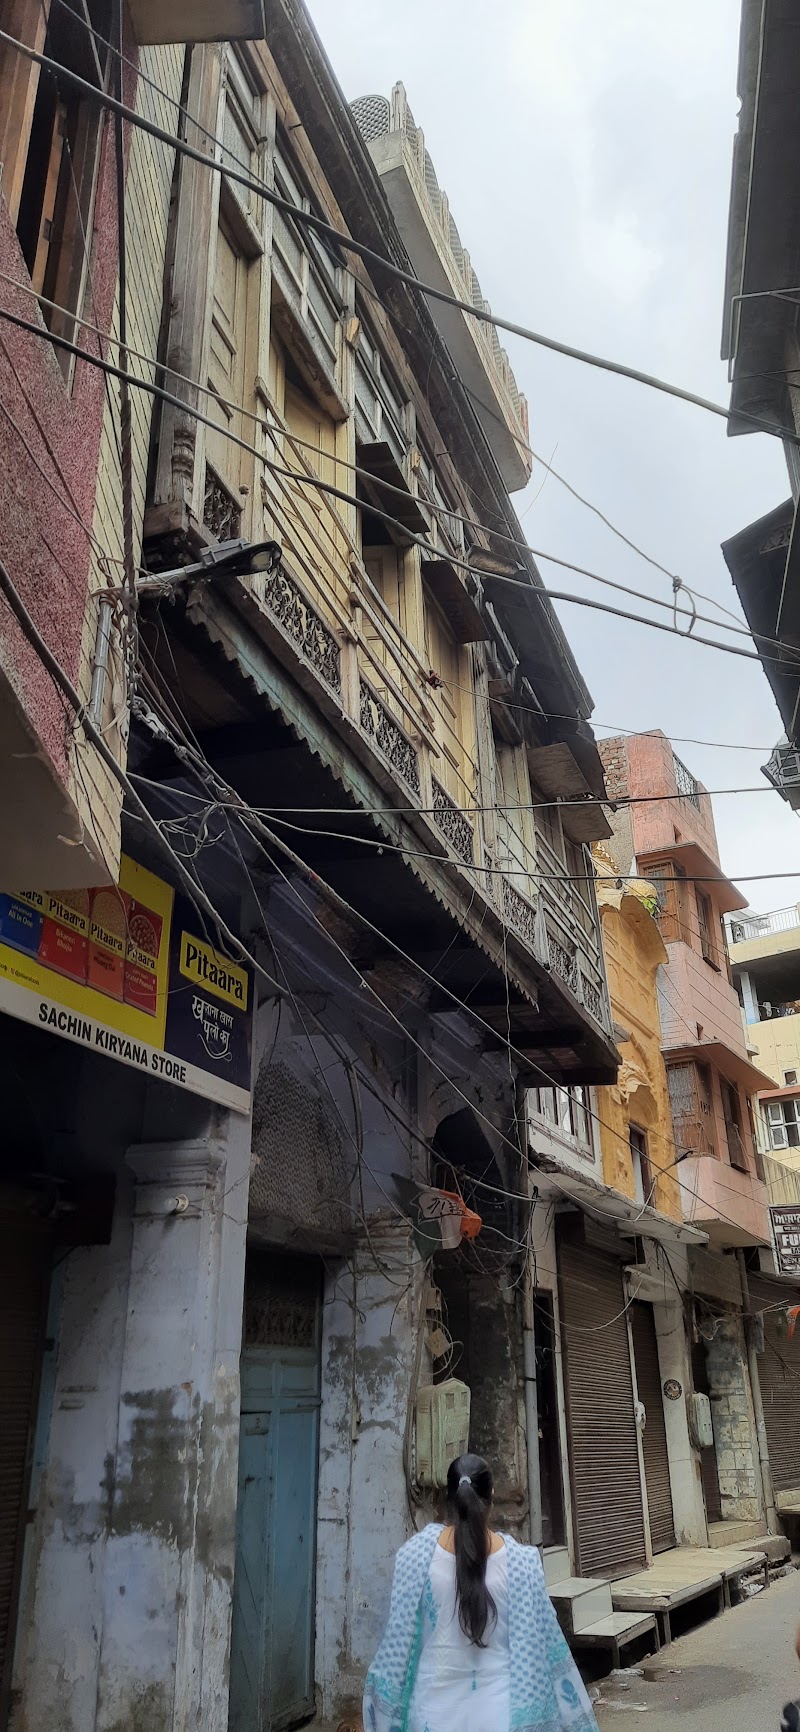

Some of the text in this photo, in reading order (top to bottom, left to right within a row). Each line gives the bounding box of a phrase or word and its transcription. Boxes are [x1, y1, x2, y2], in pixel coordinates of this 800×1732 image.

[49, 898, 86, 930] Pitaara
[90, 922, 123, 951] Pitaara
[185, 941, 244, 1001] Pitaara
[38, 1002, 187, 1083] SACHIN KIRYANA STORE
